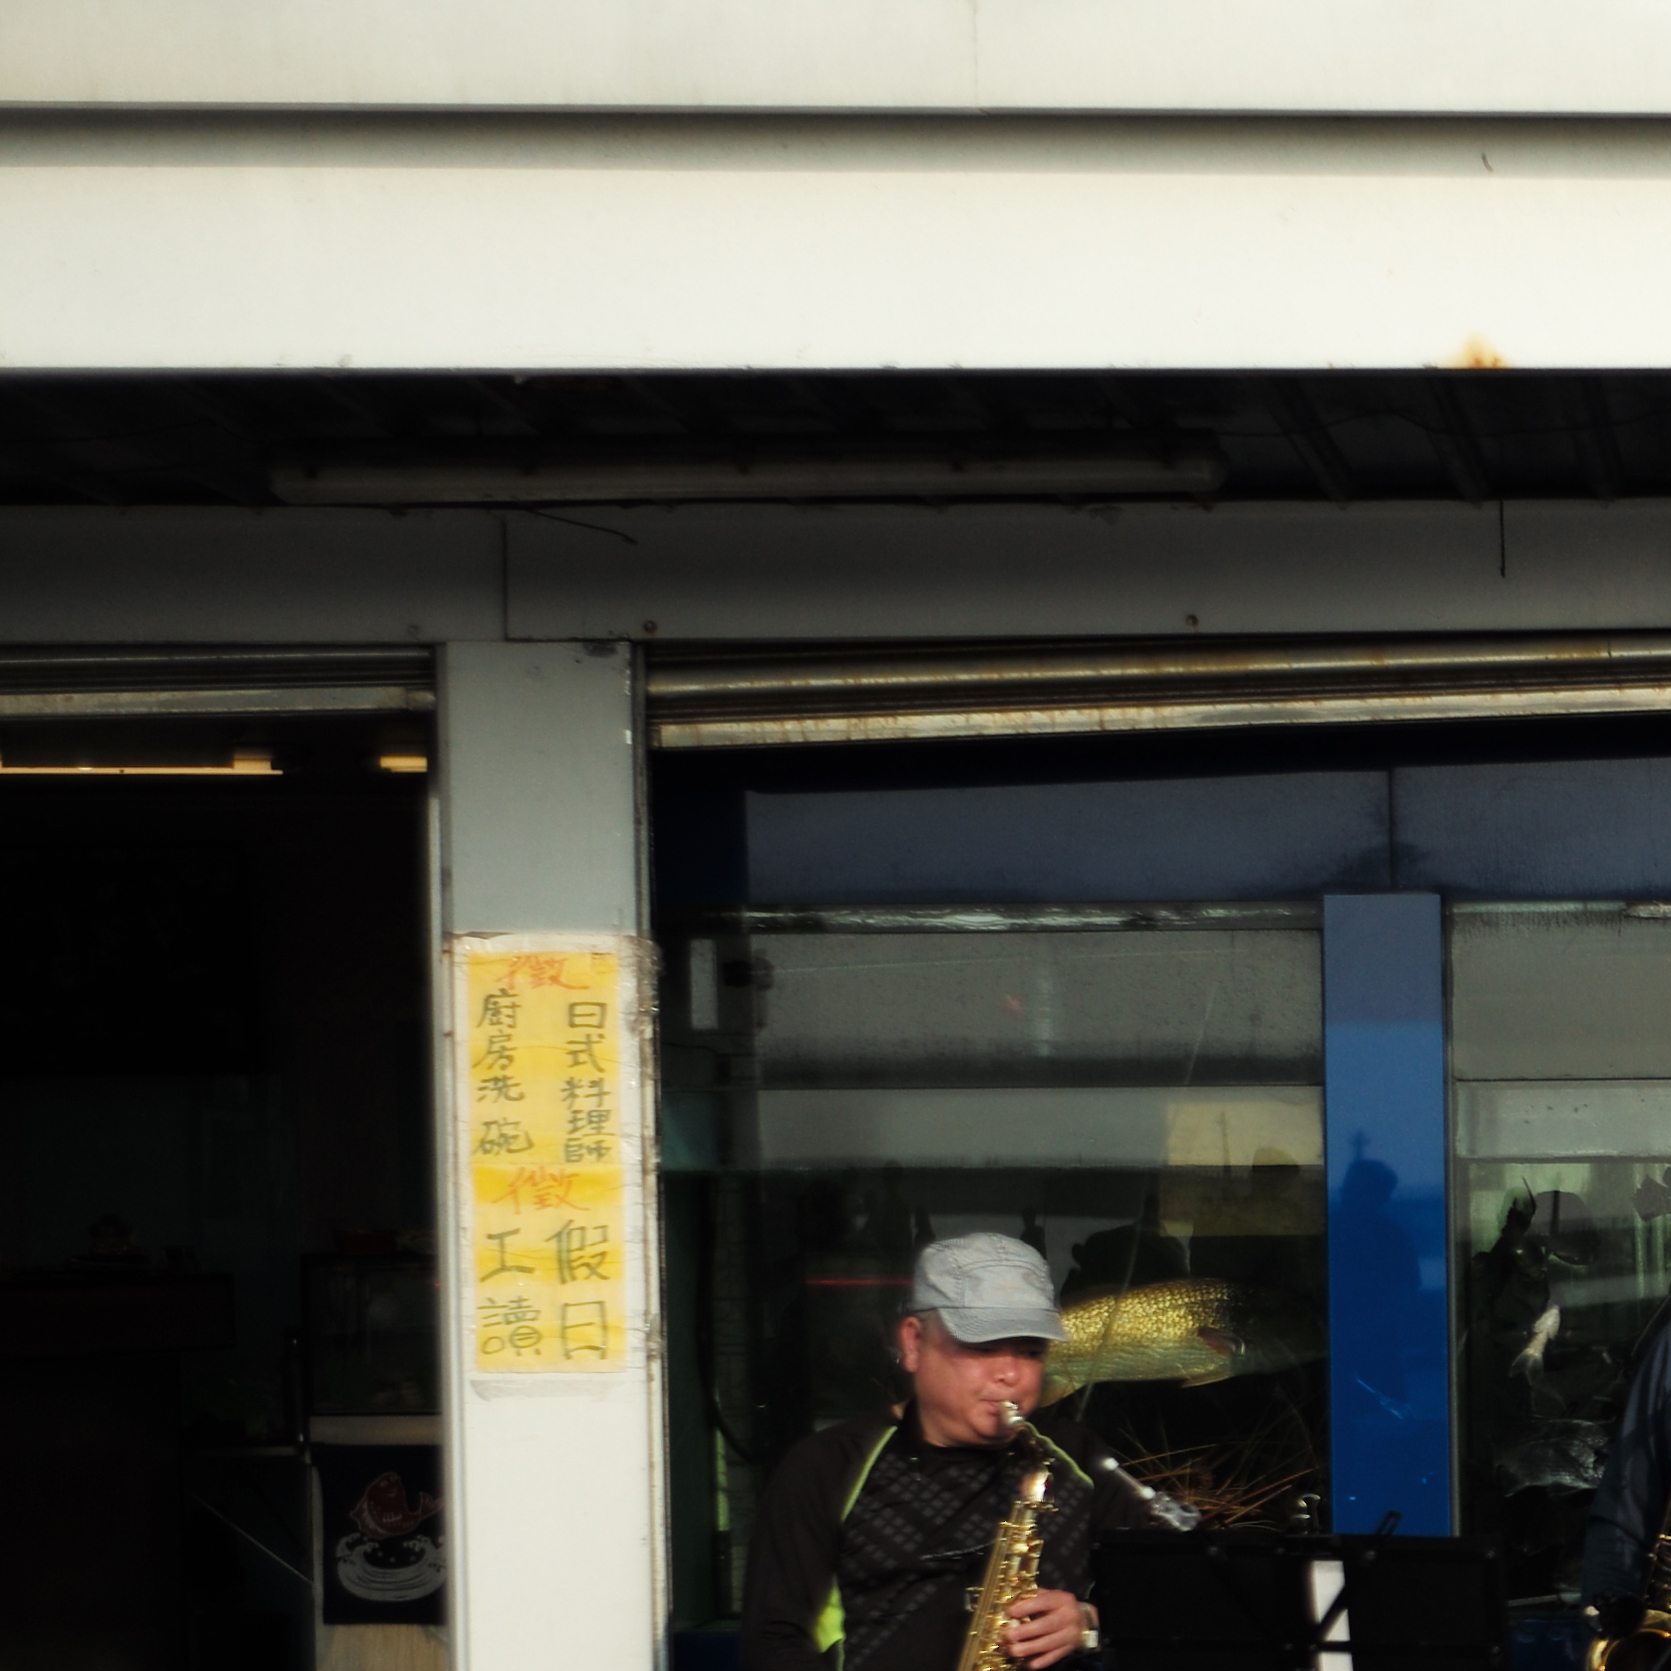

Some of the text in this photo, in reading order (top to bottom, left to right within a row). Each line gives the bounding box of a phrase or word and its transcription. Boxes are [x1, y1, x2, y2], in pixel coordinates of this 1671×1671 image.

[471, 987, 533, 1157] 廚房洗碗
[560, 1001, 615, 1164] 日式料理師
[479, 1227, 543, 1358] 工讀
[544, 1219, 610, 1360] 假日
